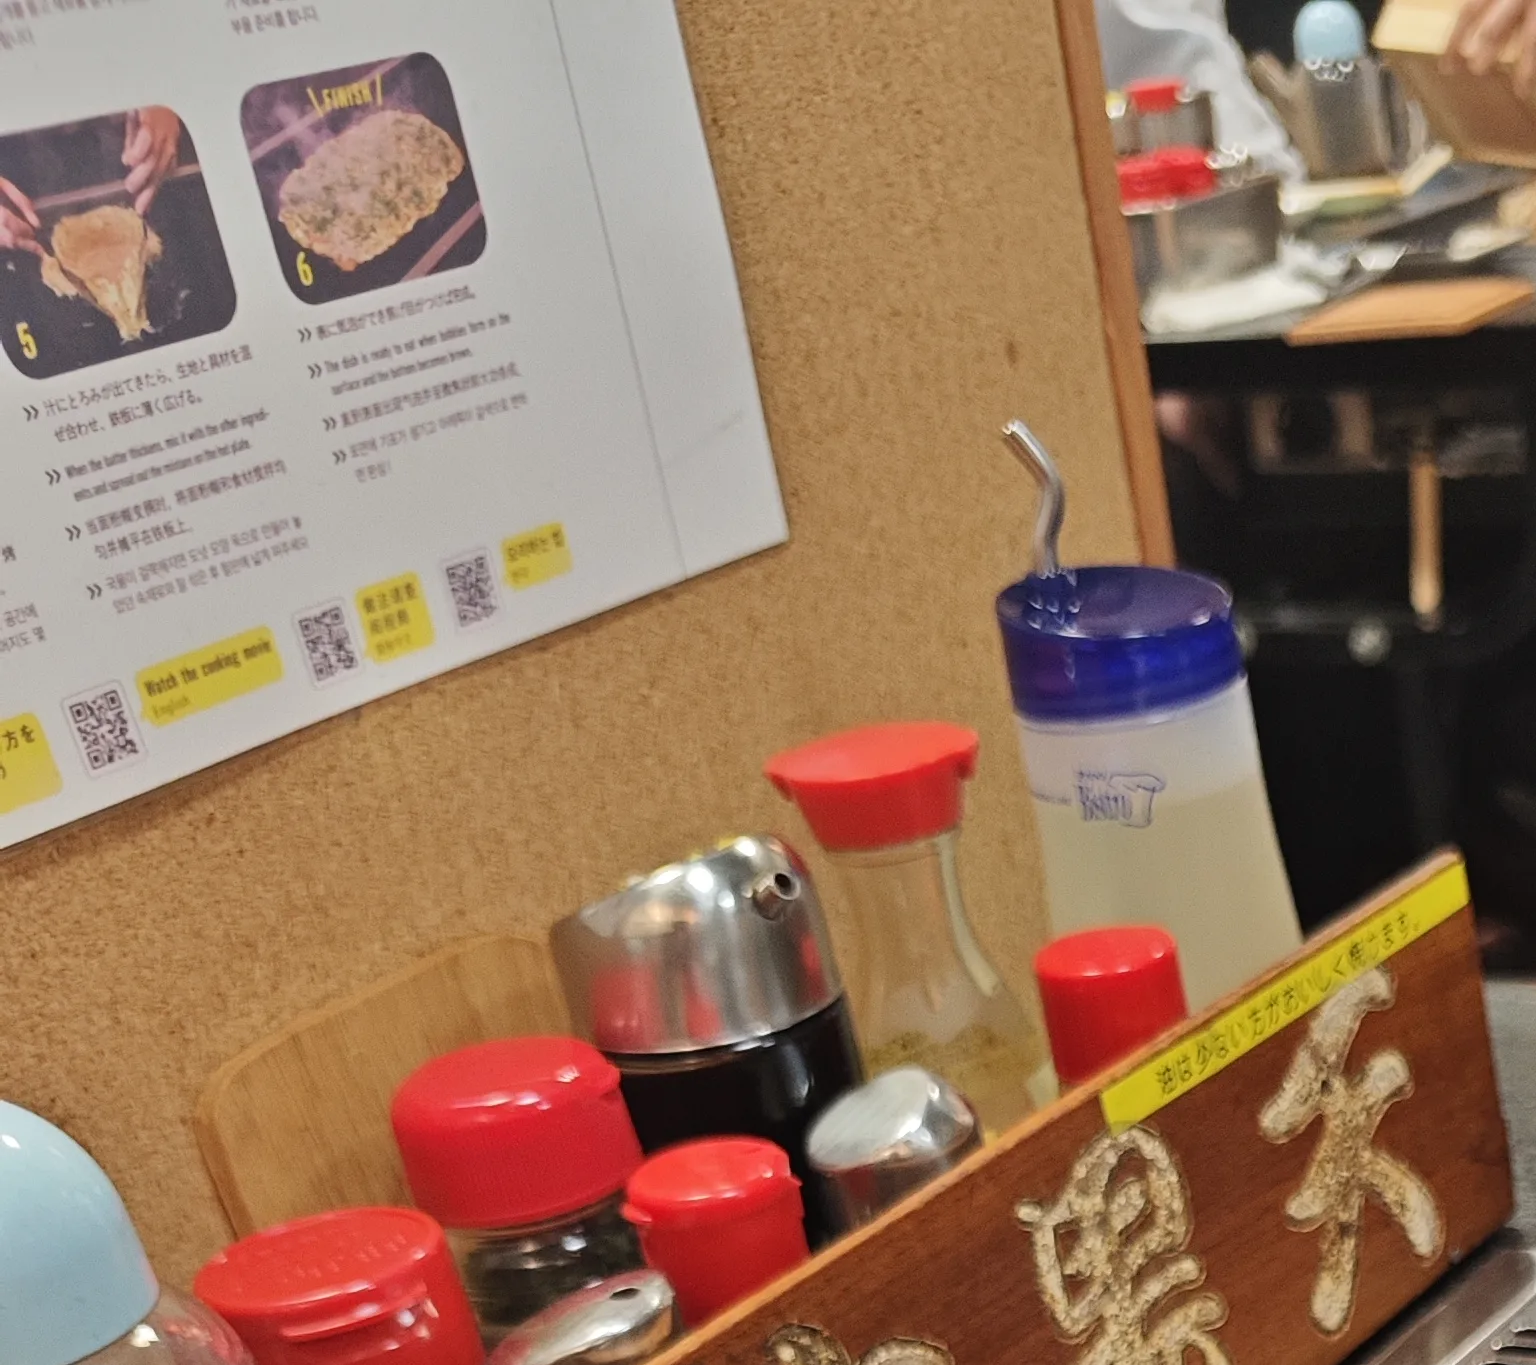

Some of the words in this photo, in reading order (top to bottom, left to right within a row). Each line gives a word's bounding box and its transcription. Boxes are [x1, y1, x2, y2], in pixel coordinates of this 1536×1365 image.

[296, 251, 313, 287] 6
[16, 322, 38, 360] 5
[144, 671, 180, 697] Watch
[180, 665, 199, 685] the
[201, 650, 242, 678] cooking
